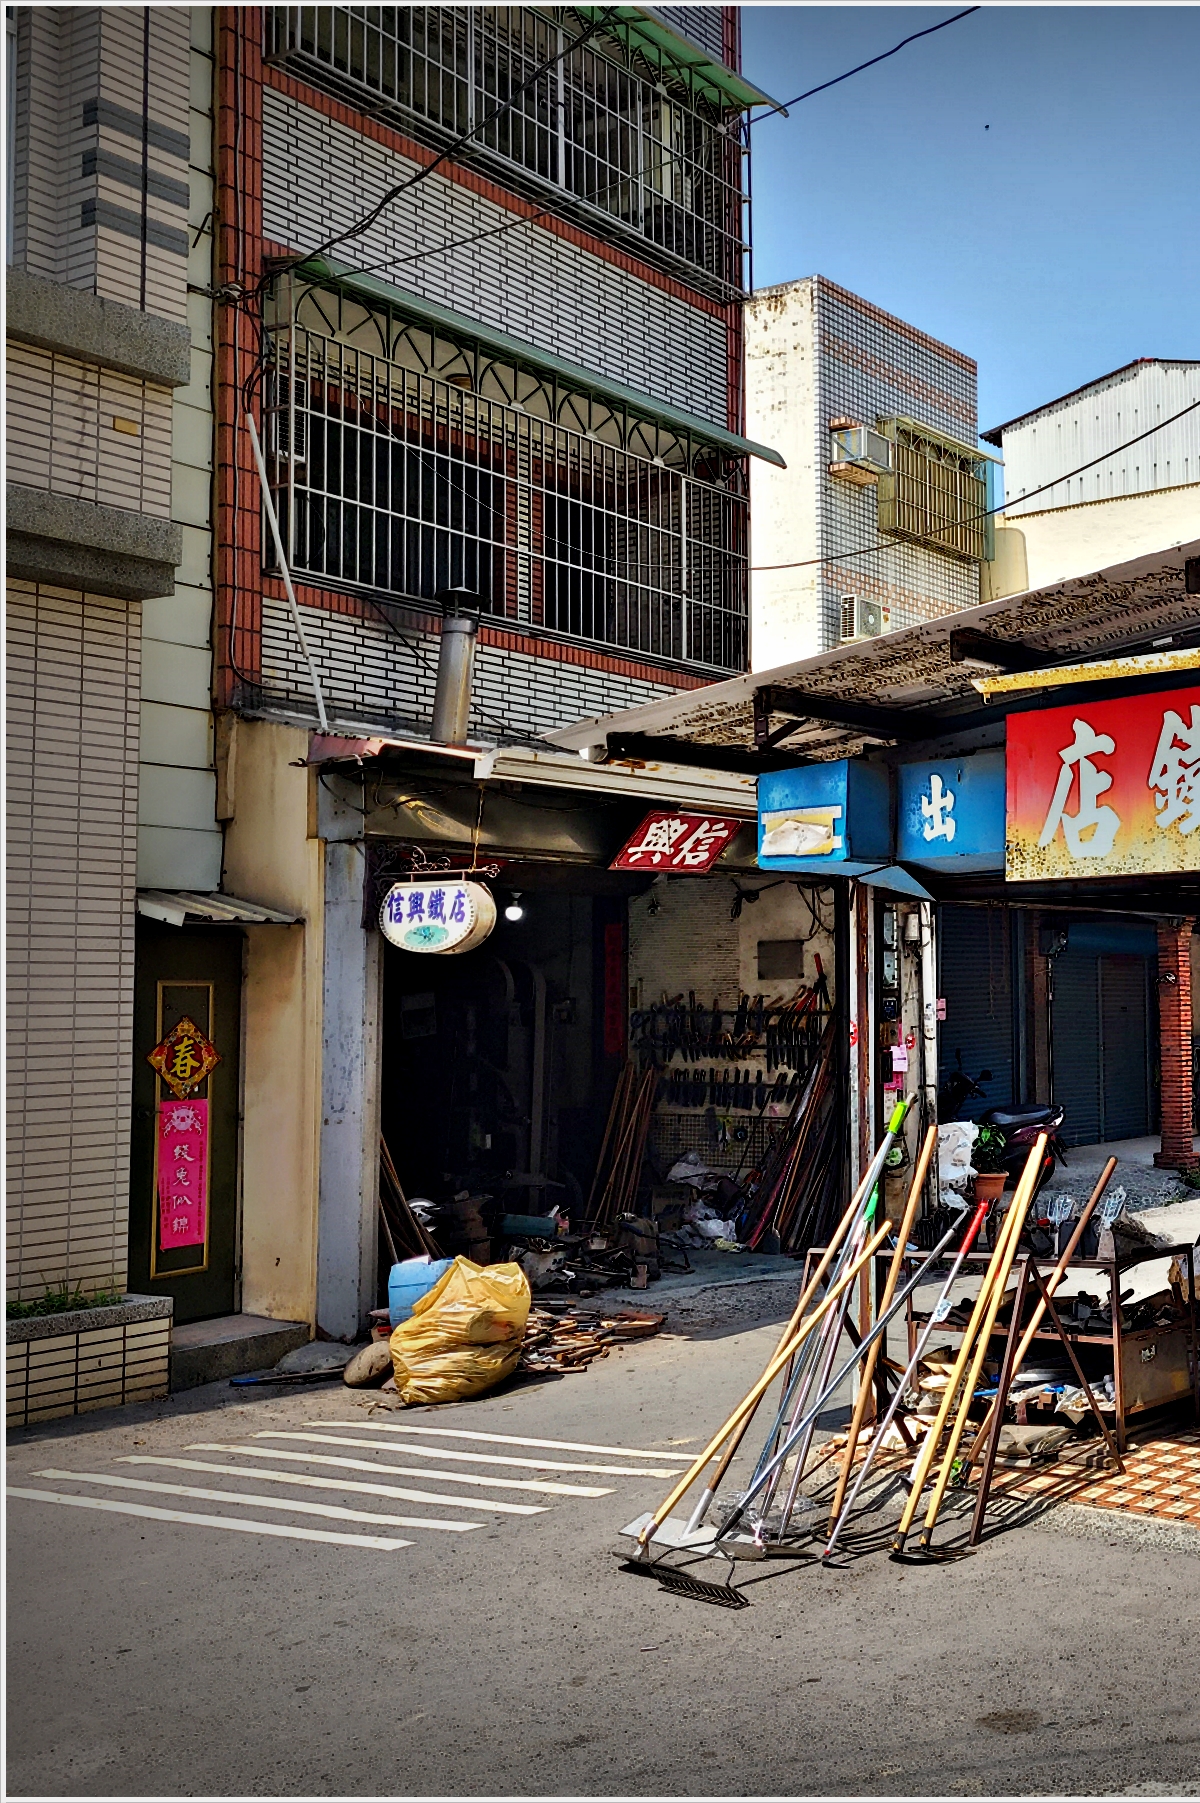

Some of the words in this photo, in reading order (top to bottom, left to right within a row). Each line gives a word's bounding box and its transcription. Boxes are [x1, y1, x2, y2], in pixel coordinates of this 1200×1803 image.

[921, 774, 957, 843] 出
[387, 888, 467, 925] 信興鐵店
[170, 1038, 200, 1078] 春
